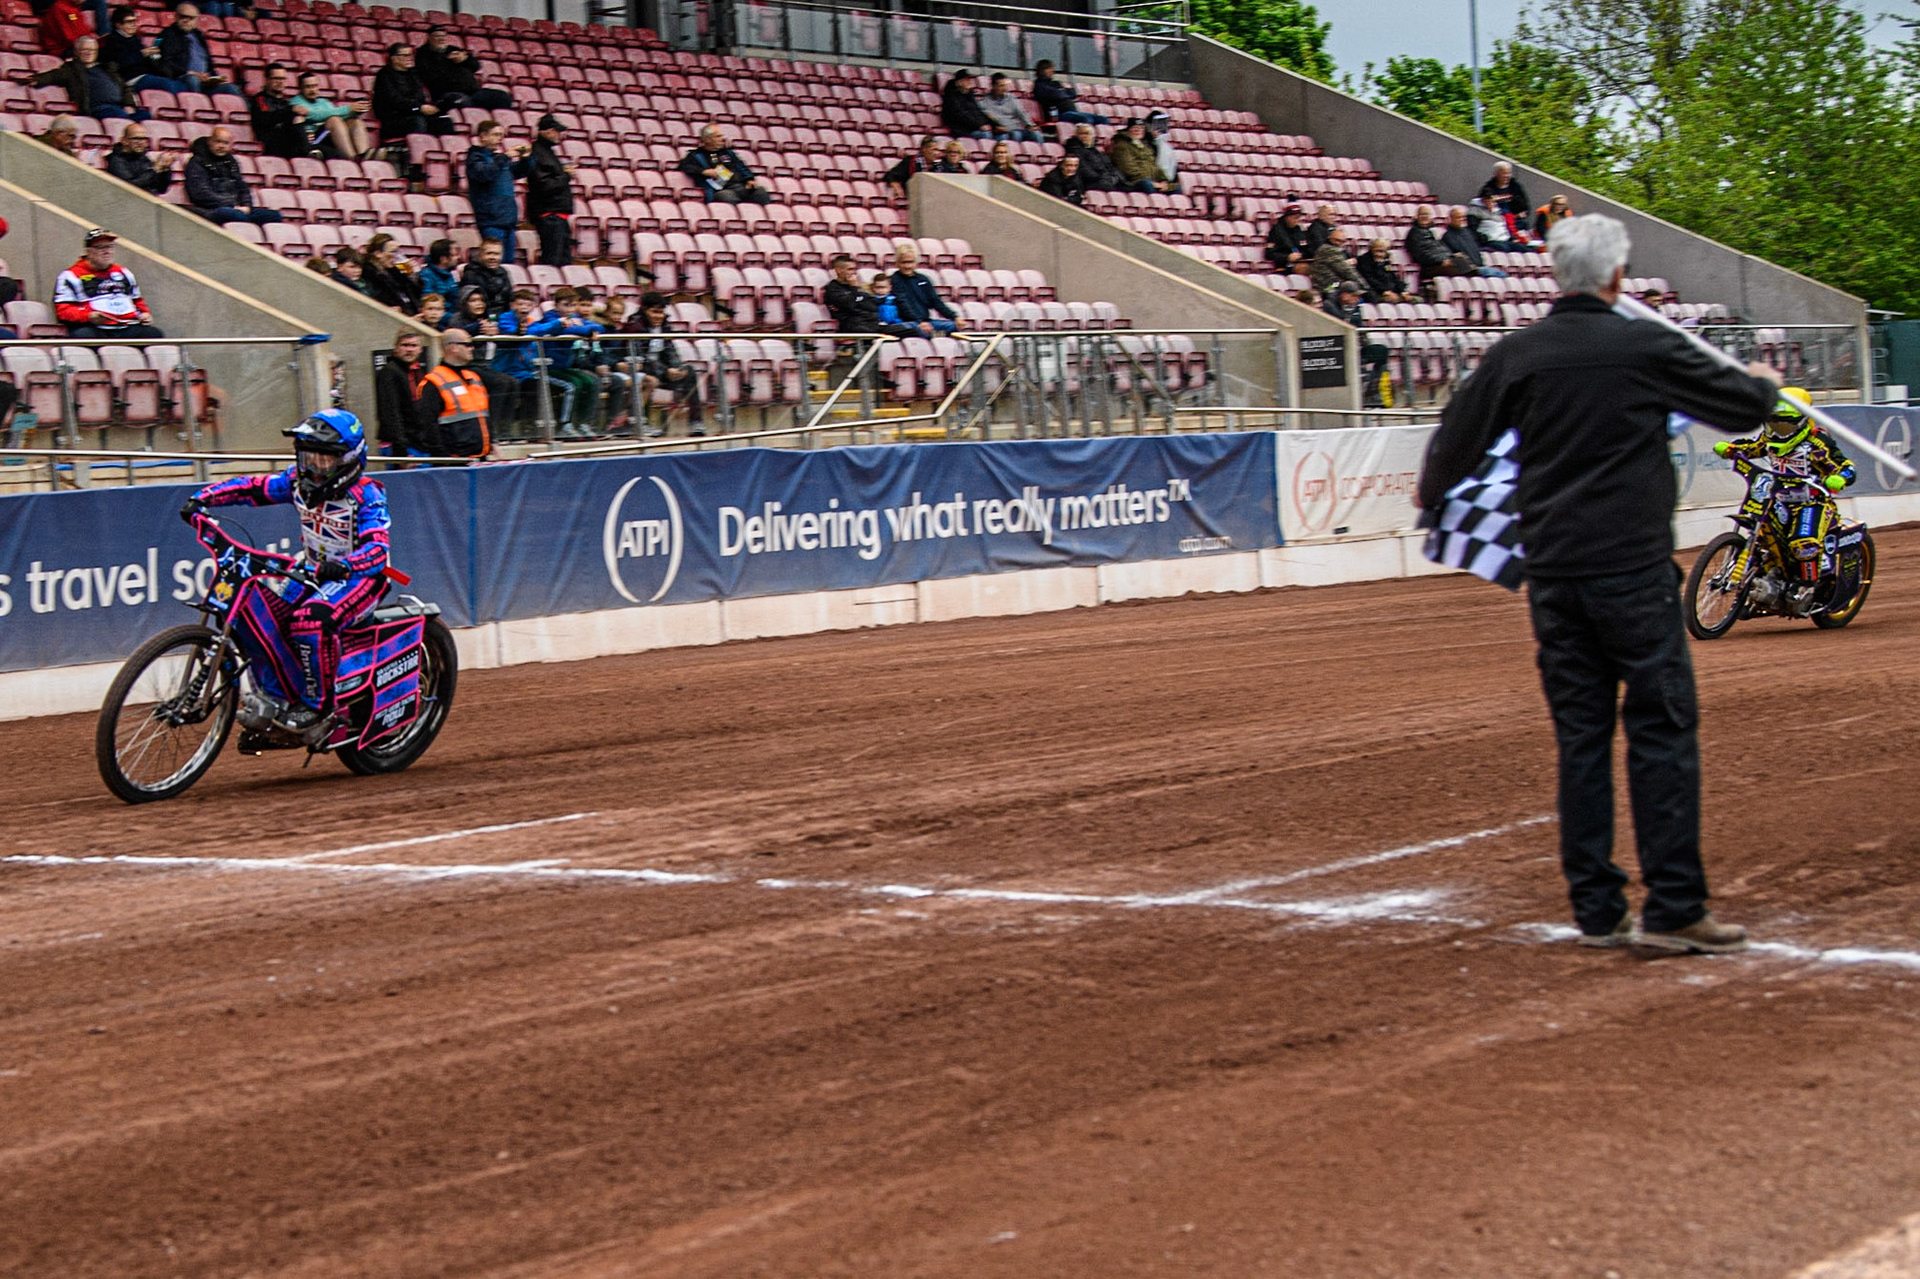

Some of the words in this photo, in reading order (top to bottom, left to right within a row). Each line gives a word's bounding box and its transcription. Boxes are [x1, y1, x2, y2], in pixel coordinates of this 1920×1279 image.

[617, 519, 671, 558] ATPI
[718, 498, 882, 560] Delivering
[885, 491, 967, 543] what
[973, 486, 1053, 545] really
[26, 547, 158, 613] travel
[376, 654, 419, 688] ROCKSTAR
